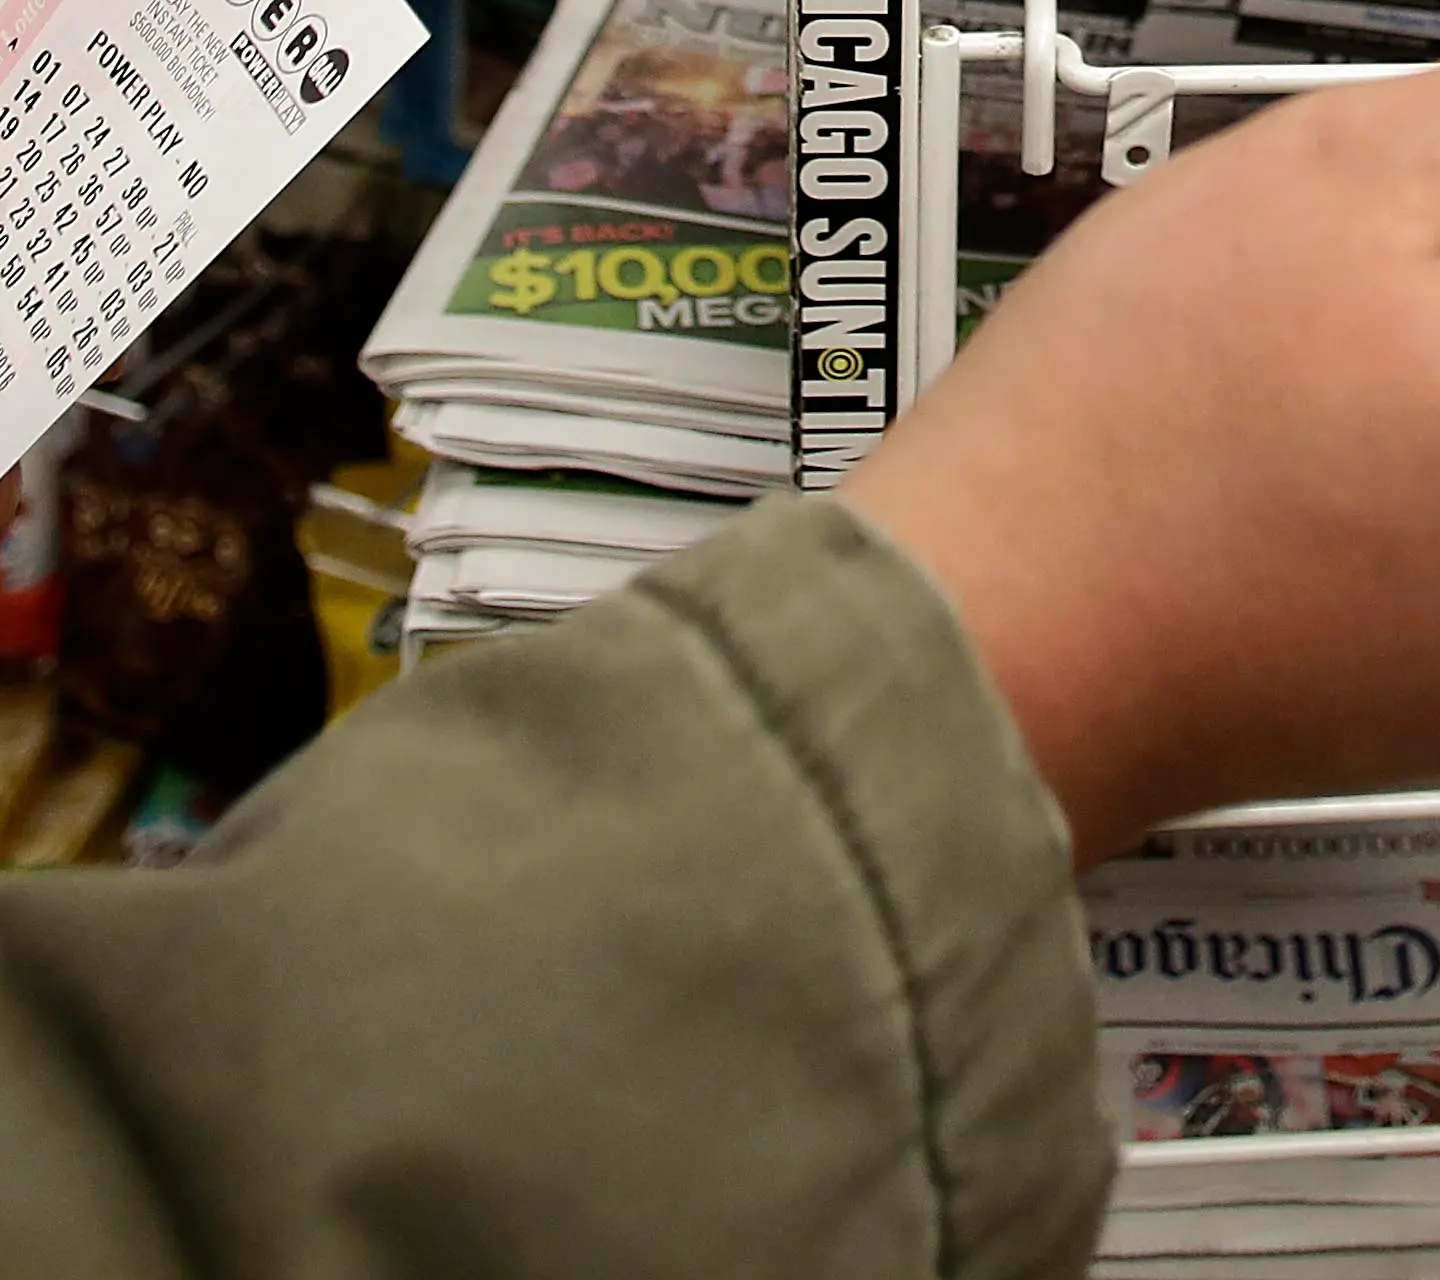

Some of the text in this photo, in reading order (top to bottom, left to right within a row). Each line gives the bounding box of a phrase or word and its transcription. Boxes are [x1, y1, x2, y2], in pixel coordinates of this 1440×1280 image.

[130, 11, 172, 62] $500,000
[166, 55, 187, 82] BIG
[186, 10, 209, 39] THE
[202, 31, 230, 64] NEW
[187, 45, 218, 86] TICKET
[33, 50, 61, 84] 01
[62, 84, 90, 116] 07
[84, 116, 110, 150] 24
[103, 147, 130, 177] 27
[122, 177, 148, 210] 38
[153, 232, 179, 265] 21
[87, 30, 208, 198] POWER PLAY NO
[14, 79, 41, 113] 14
[41, 113, 66, 143] 17
[60, 144, 85, 175] 26
[78, 174, 103, 206] 36
[96, 204, 122, 236] 57
[127, 261, 152, 293] 03
[16, 139, 42, 172] 20
[35, 171, 61, 203] 25
[53, 203, 78, 235] 42
[71, 234, 94, 265] 45
[100, 289, 125, 321] 03
[0, 254, 25, 288] 50
[17, 286, 43, 322] 54
[46, 345, 71, 379] 05
[10, 197, 35, 230] 23
[27, 228, 52, 263] 32
[44, 262, 69, 293] 41
[73, 317, 98, 350] 26
[489, 245, 790, 316] $10,00
[635, 297, 788, 330] MEG
[800, 217, 888, 350] SUN
[802, 368, 887, 491] TIM
